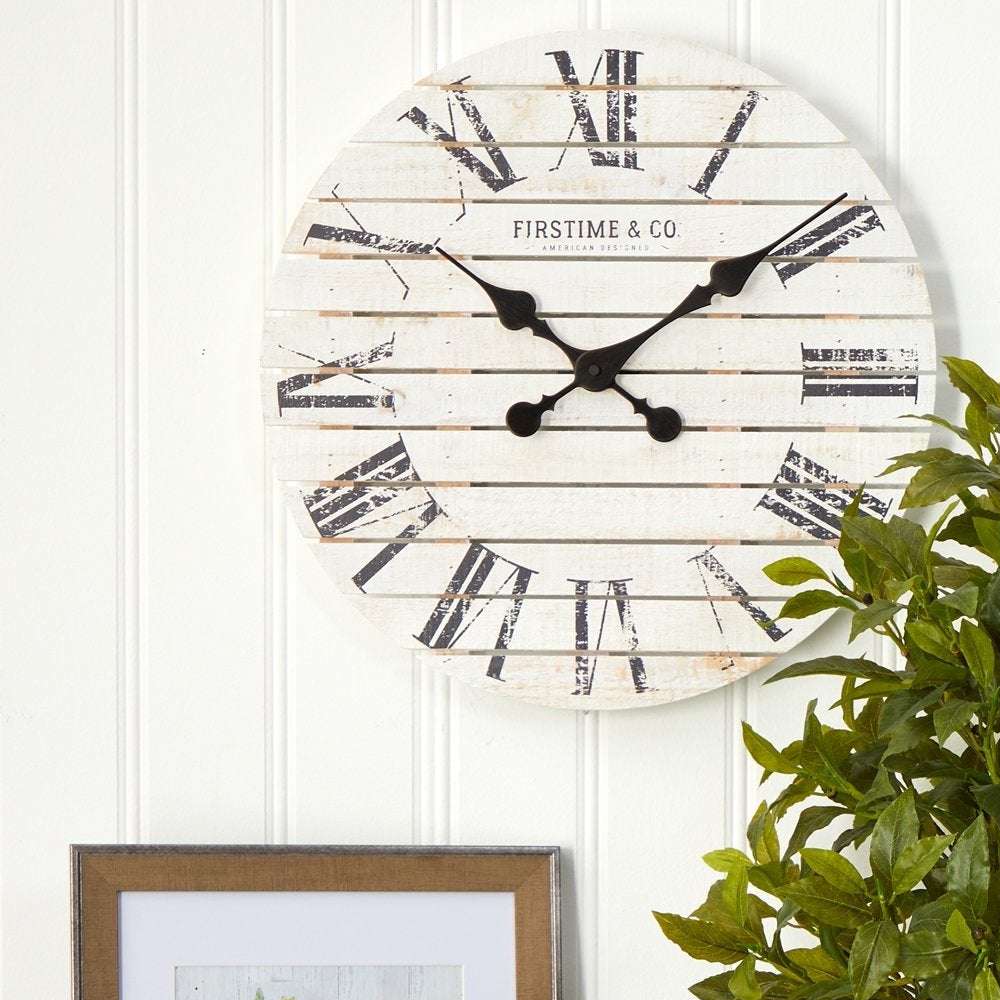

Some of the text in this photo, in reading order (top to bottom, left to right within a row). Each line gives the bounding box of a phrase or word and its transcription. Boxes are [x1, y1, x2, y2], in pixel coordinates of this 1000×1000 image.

[545, 49, 644, 171] XII
[513, 220, 619, 239] FIRSTIME
[627, 220, 641, 239] &
[800, 342, 919, 405] III
